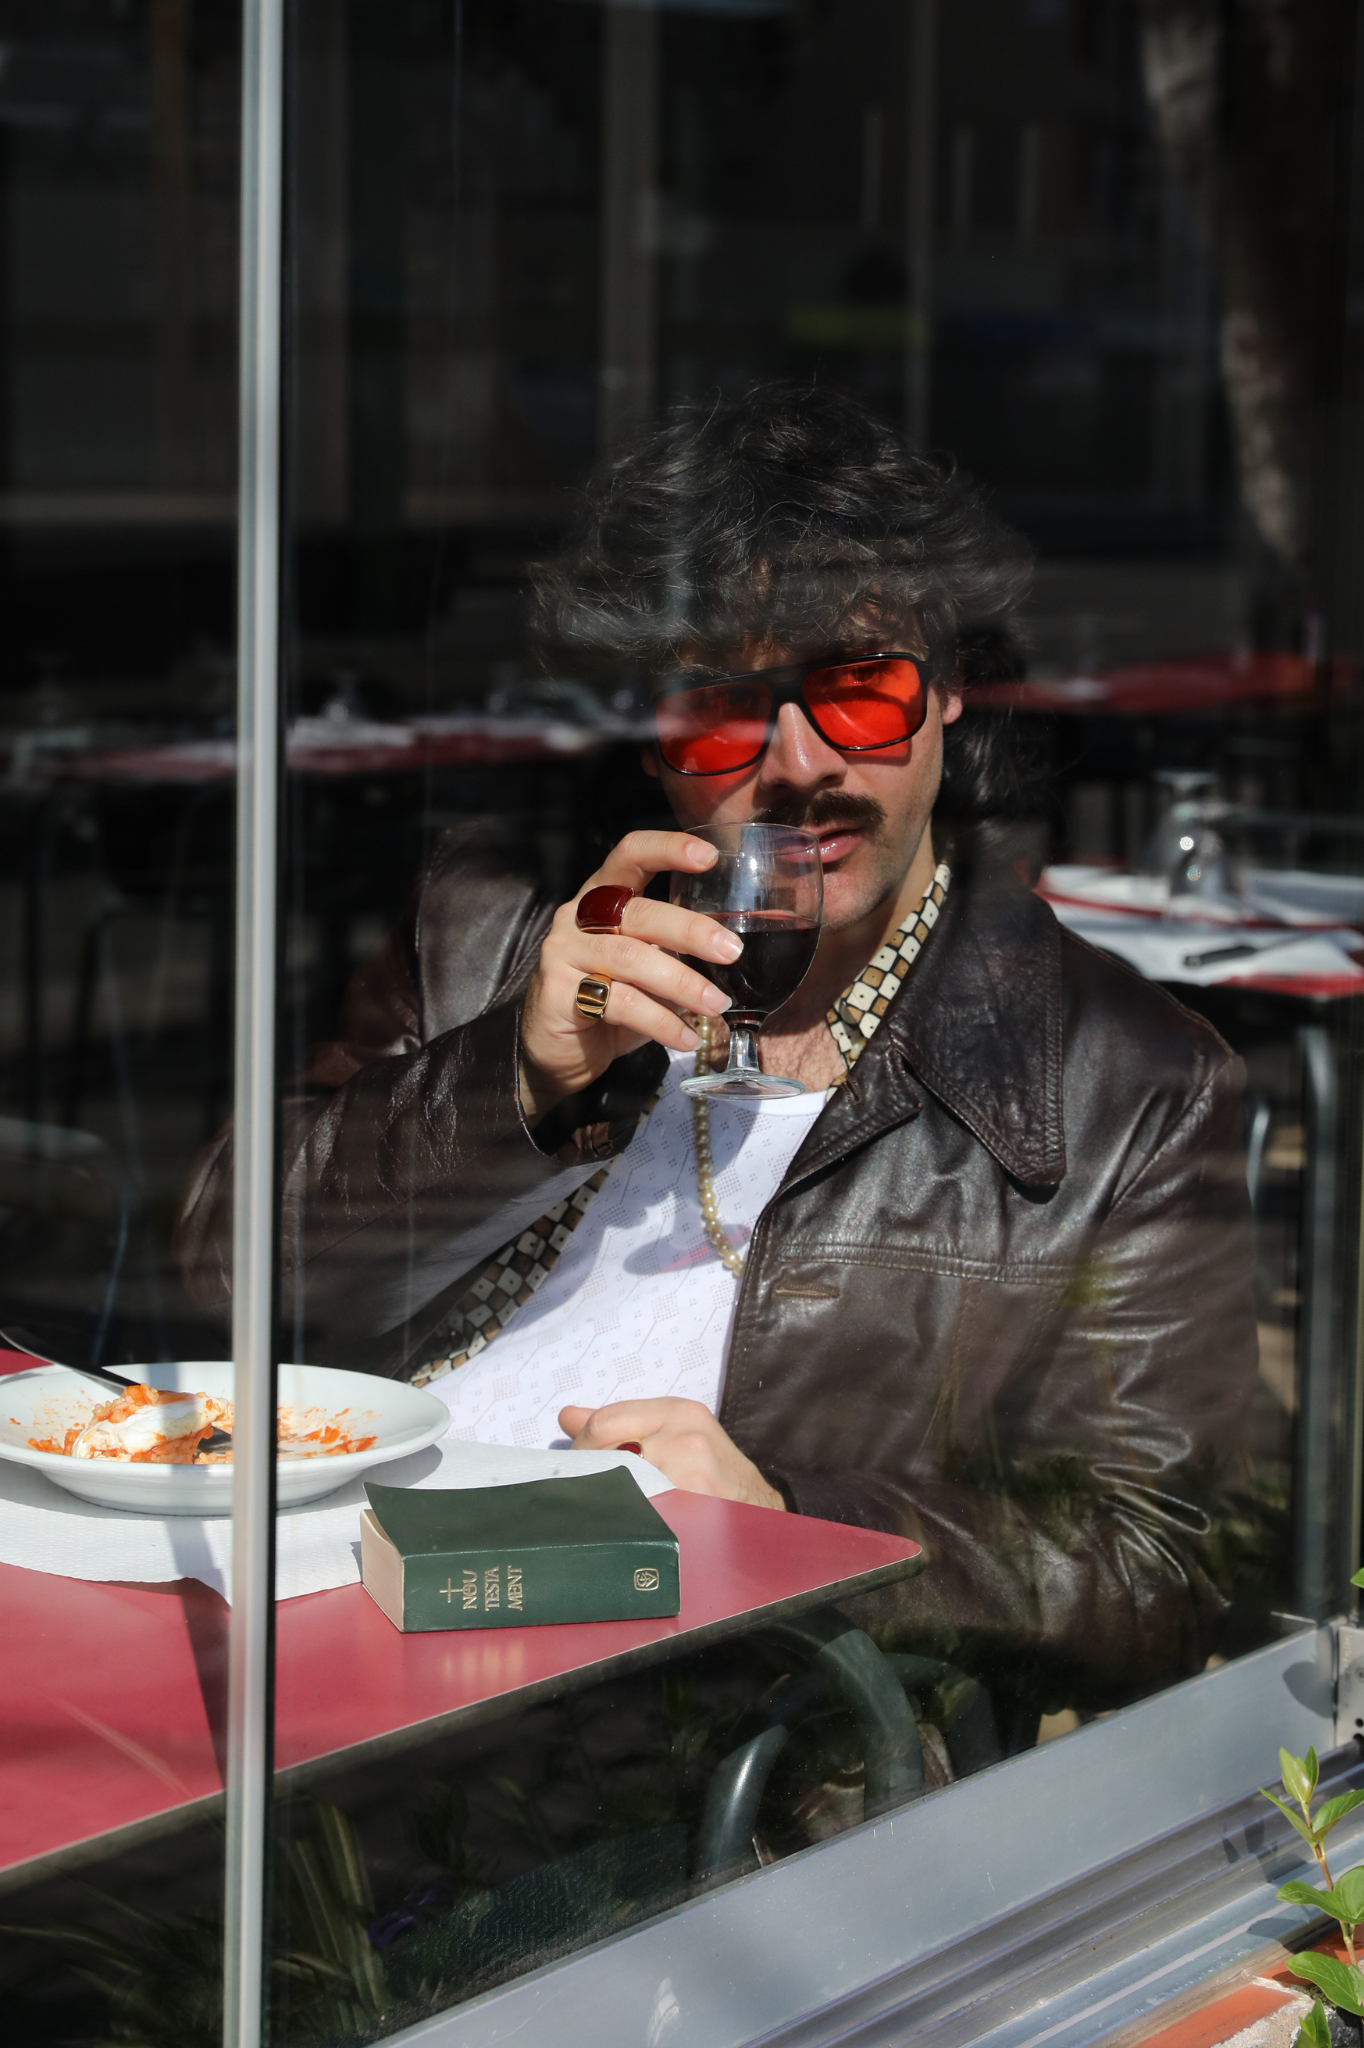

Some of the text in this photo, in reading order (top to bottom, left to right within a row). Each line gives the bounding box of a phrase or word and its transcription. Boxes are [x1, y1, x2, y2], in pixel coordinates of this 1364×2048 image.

[463, 1569, 477, 1610] NOU
[485, 1566, 499, 1611] TESTA
[508, 1565, 523, 1611] MENT
